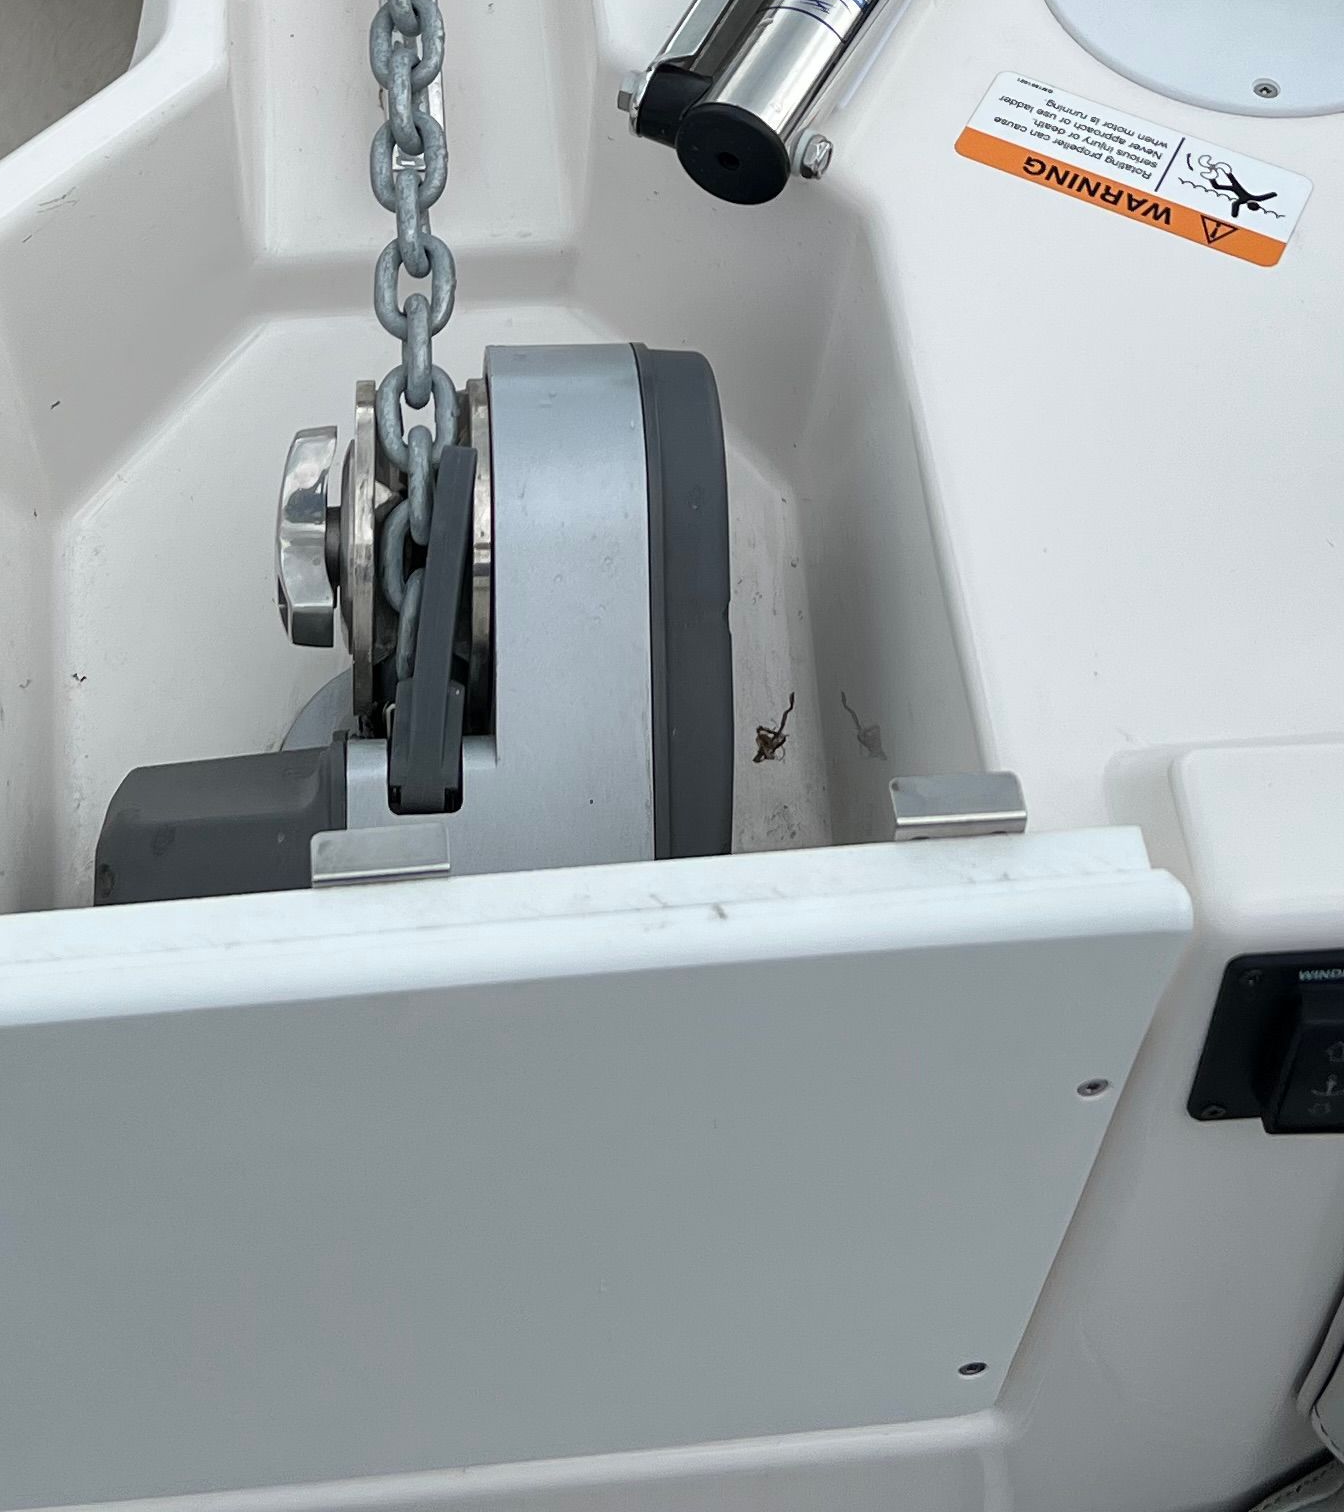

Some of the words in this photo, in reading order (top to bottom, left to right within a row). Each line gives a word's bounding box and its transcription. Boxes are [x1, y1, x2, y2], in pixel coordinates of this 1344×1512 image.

[999, 96, 1034, 113] ladder
[1036, 109, 1056, 120] use
[1090, 117, 1100, 125] is
[994, 117, 1027, 132] cause
[1102, 122, 1135, 136] motor
[1030, 130, 1050, 140] can
[1068, 132, 1080, 140] or
[1074, 122, 1126, 145] approach
[1138, 134, 1167, 148] when
[1052, 140, 1103, 160] propeller
[1082, 137, 1114, 154] injury
[1128, 143, 1162, 160] Never
[1116, 149, 1157, 168] serious
[1104, 156, 1152, 179] Rotating
[1023, 156, 1171, 225] WARNING
